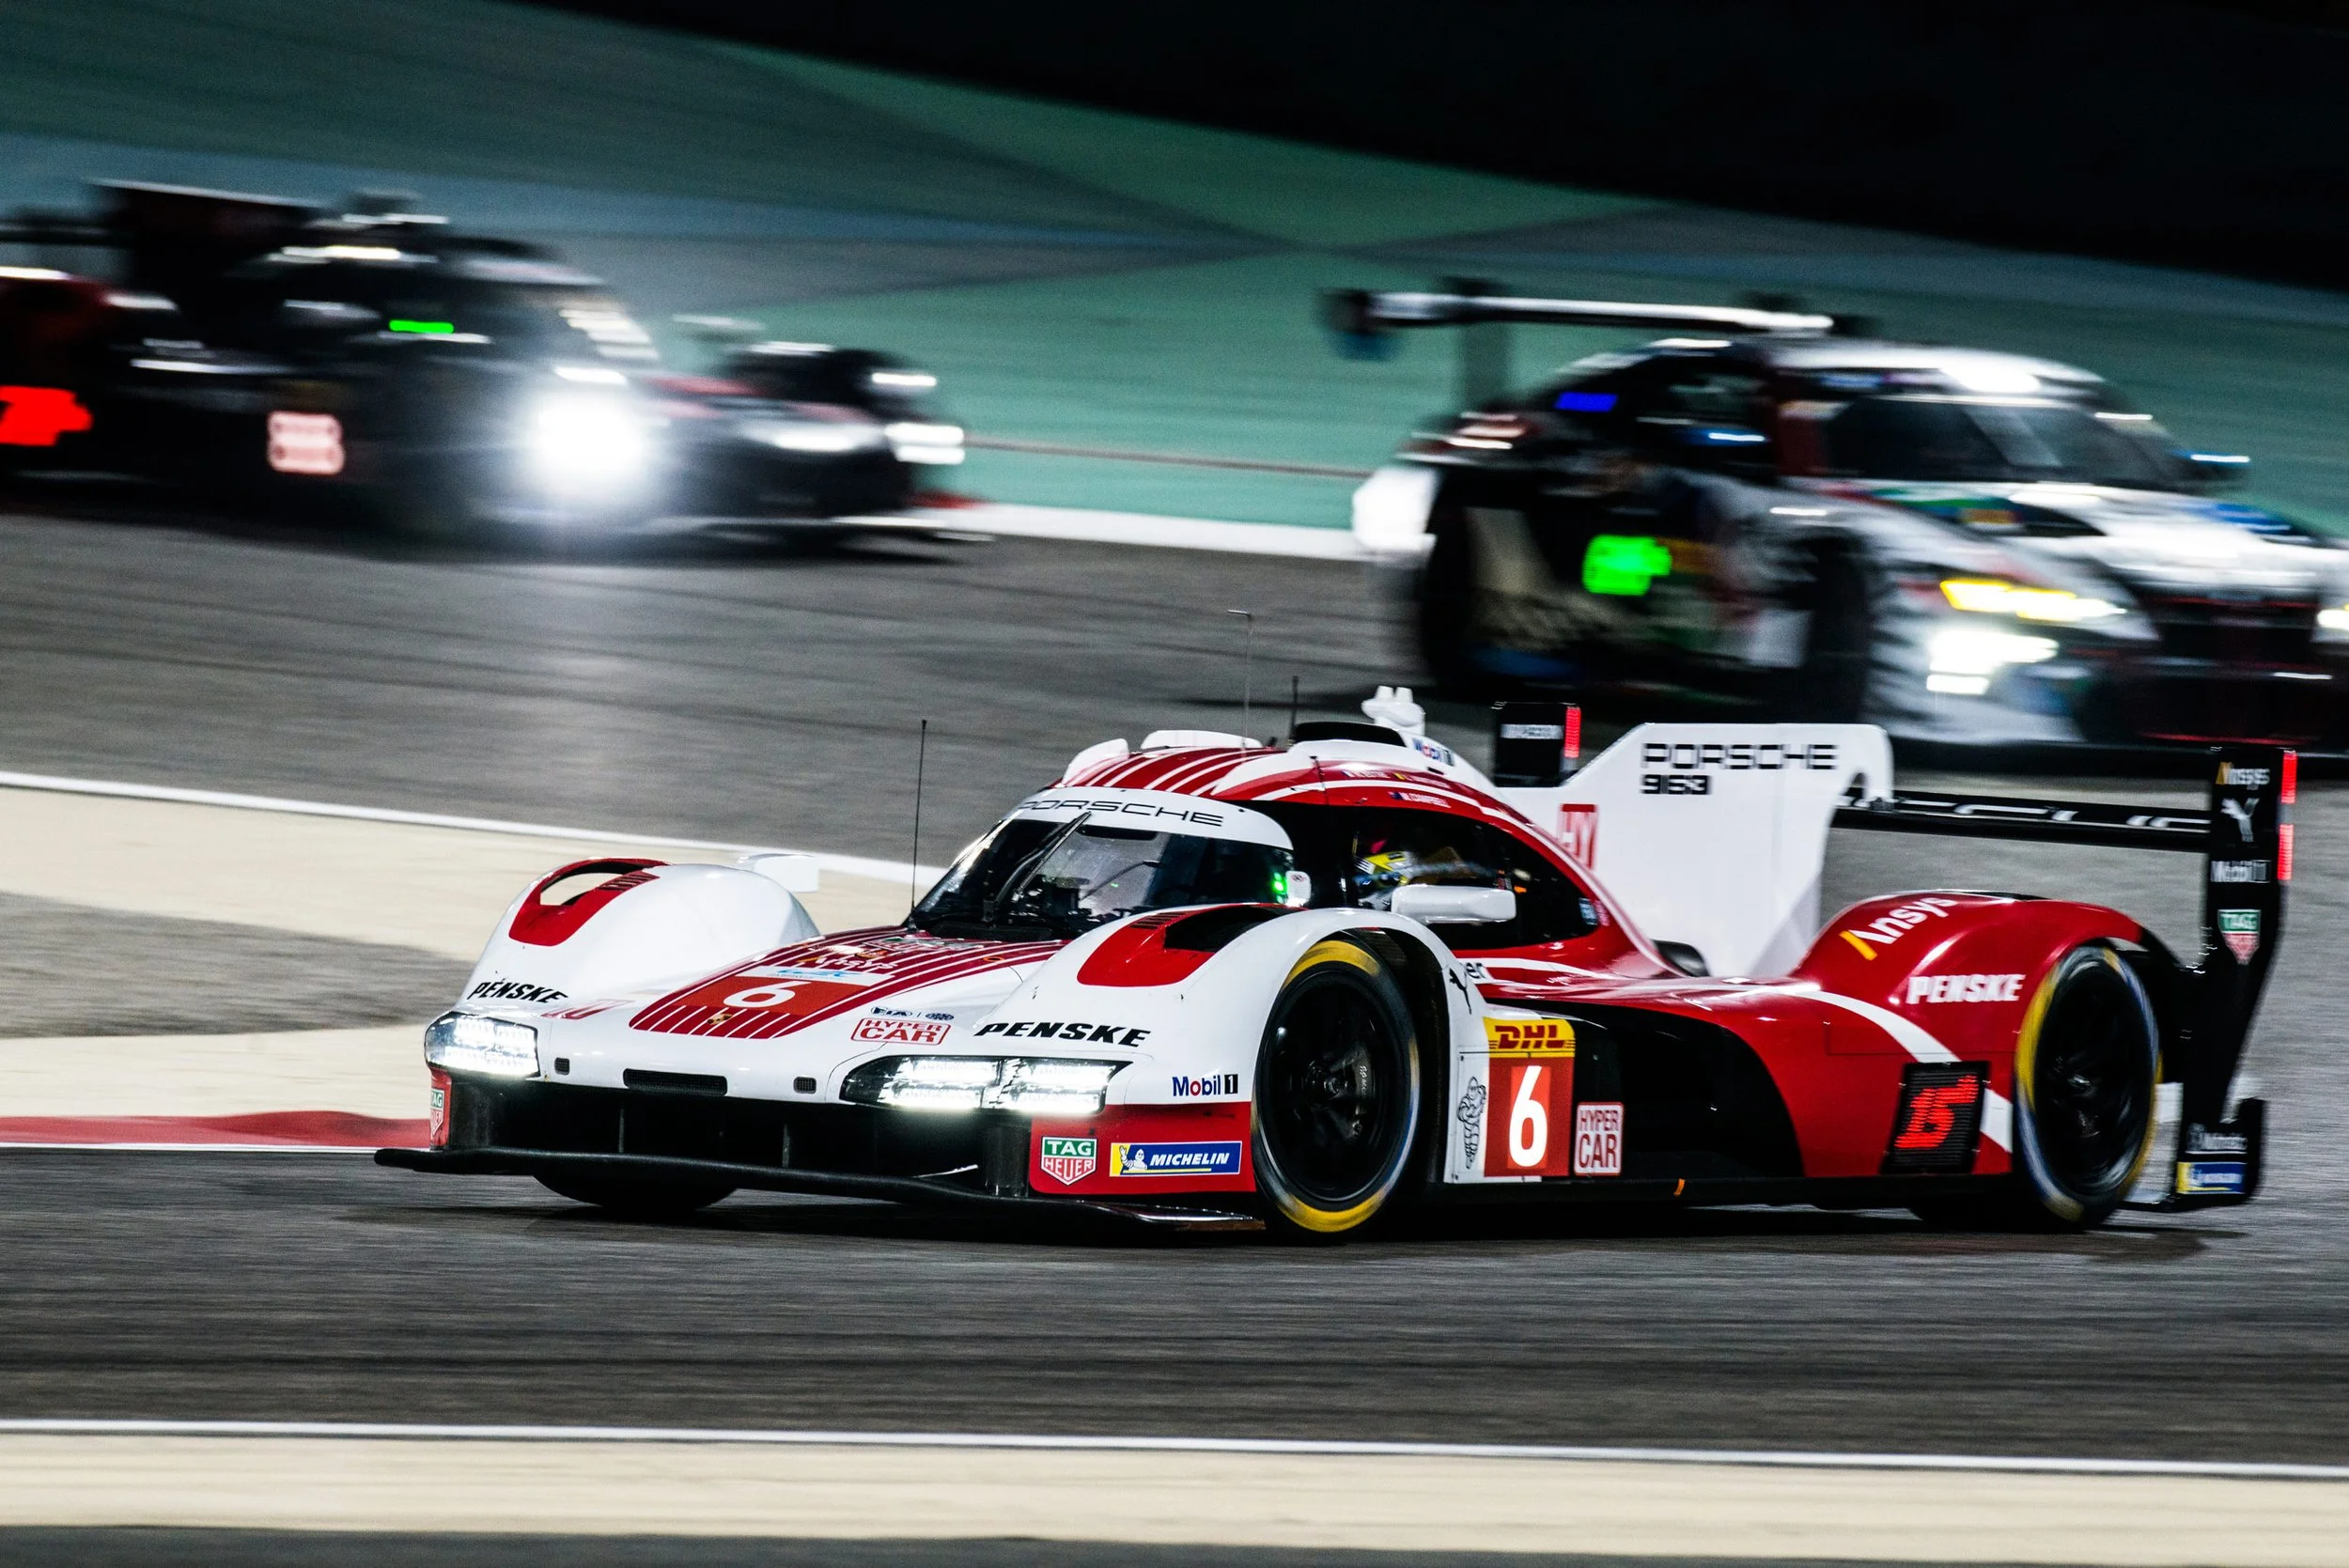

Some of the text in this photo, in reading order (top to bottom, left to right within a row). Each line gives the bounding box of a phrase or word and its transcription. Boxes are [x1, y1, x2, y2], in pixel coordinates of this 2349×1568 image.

[1641, 743, 1839, 769] PORSCHE
[1640, 774, 1712, 795] 963
[1018, 800, 1224, 827] PORSCHE
[1839, 897, 1959, 961] Ansys
[467, 980, 568, 1003] PENSKE
[723, 981, 813, 1009] 6
[1906, 974, 2026, 1004] PENSKE
[860, 1027, 938, 1043] CAR
[864, 1019, 942, 1032] HYPER
[974, 1022, 1151, 1048] PENSKE
[1494, 1024, 1566, 1049] DHL
[1172, 1074, 1237, 1096] Mobil 1
[1508, 1064, 1548, 1168] 6
[1579, 1110, 1619, 1132] HYPER
[1047, 1141, 1092, 1157] TAG
[1149, 1152, 1230, 1167] MICHELIN
[1579, 1133, 1617, 1169] CAR
[1045, 1157, 1093, 1177] HEUER
